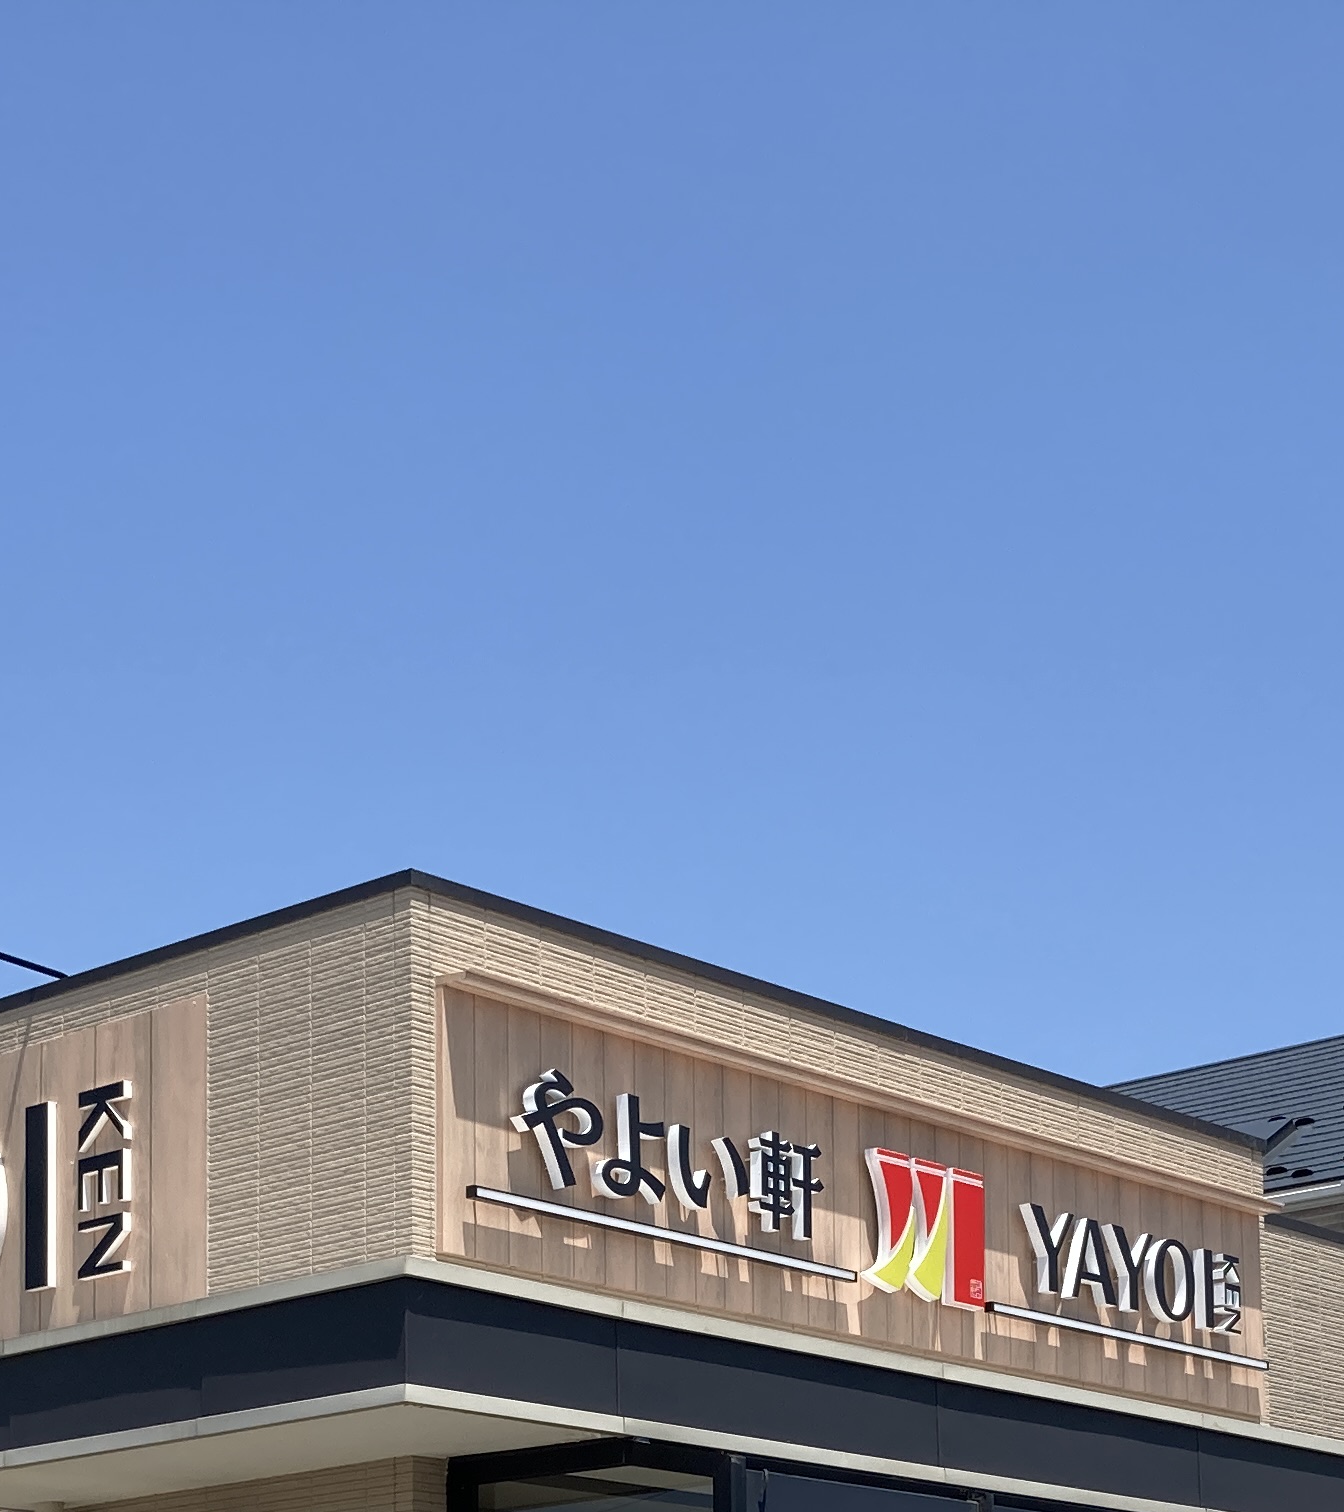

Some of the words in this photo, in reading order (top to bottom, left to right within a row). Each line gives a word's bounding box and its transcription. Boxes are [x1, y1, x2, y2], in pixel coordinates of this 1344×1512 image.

[77, 1079, 133, 1280] KEN
[510, 1068, 823, 1240] やよい軒
[1019, 1202, 1215, 1333] YAYOI
